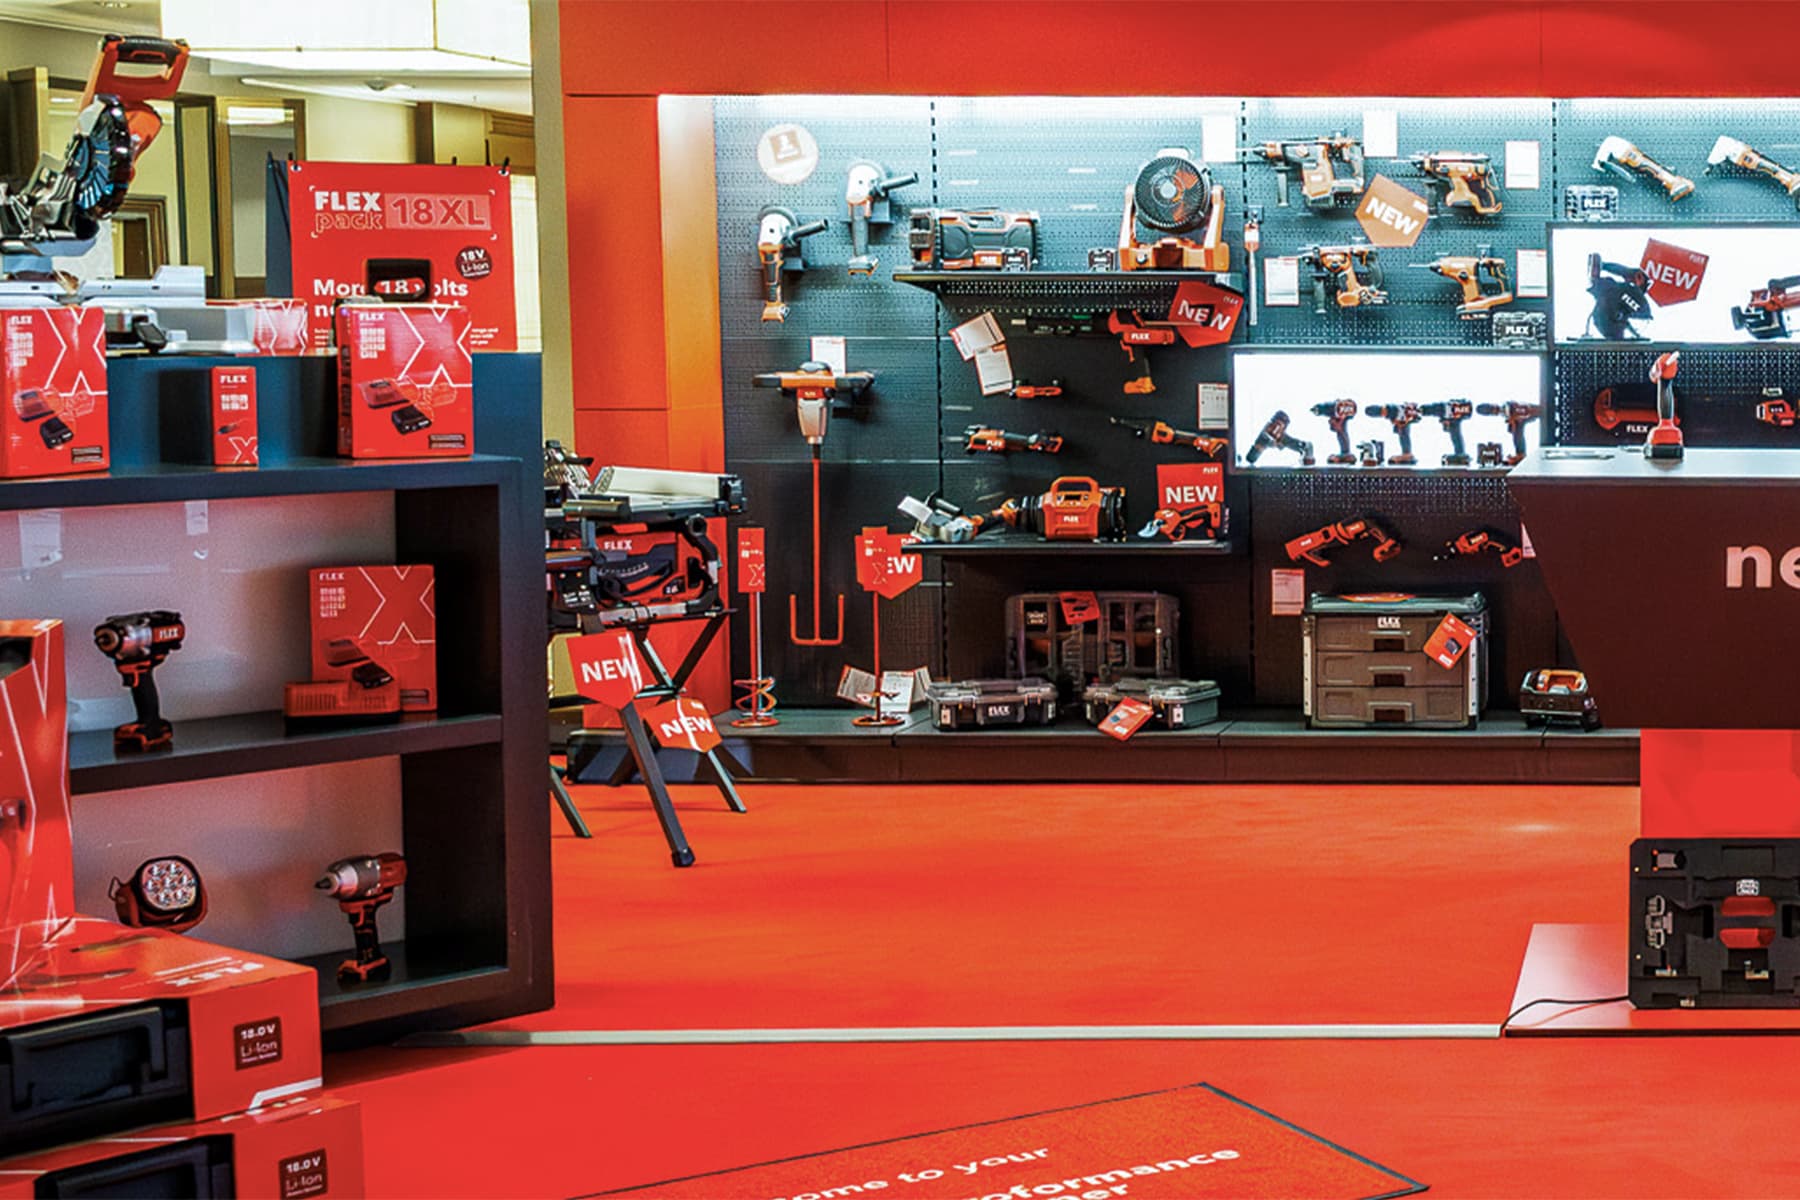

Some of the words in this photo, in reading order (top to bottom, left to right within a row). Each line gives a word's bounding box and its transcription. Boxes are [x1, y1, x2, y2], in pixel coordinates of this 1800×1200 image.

[314, 191, 382, 211] FLEX
[1583, 198, 1606, 208] FLEX
[315, 212, 383, 233] pack
[1365, 197, 1420, 235] NEW
[1643, 260, 1698, 291] NEW
[1621, 294, 1641, 311] FLEX
[359, 312, 384, 321] FLEX
[1505, 325, 1530, 335] FLEX
[220, 375, 247, 384] FLEX
[1626, 425, 1648, 434] FLEX
[1165, 486, 1218, 504] NEW
[604, 540, 633, 550] FLEX
[1378, 617, 1401, 626] FLEX
[159, 628, 178, 640] FLEX
[660, 716, 714, 738] NEW
[772, 1181, 889, 1200] ome
[897, 1169, 945, 1184] to
[953, 1148, 1049, 1175] your
